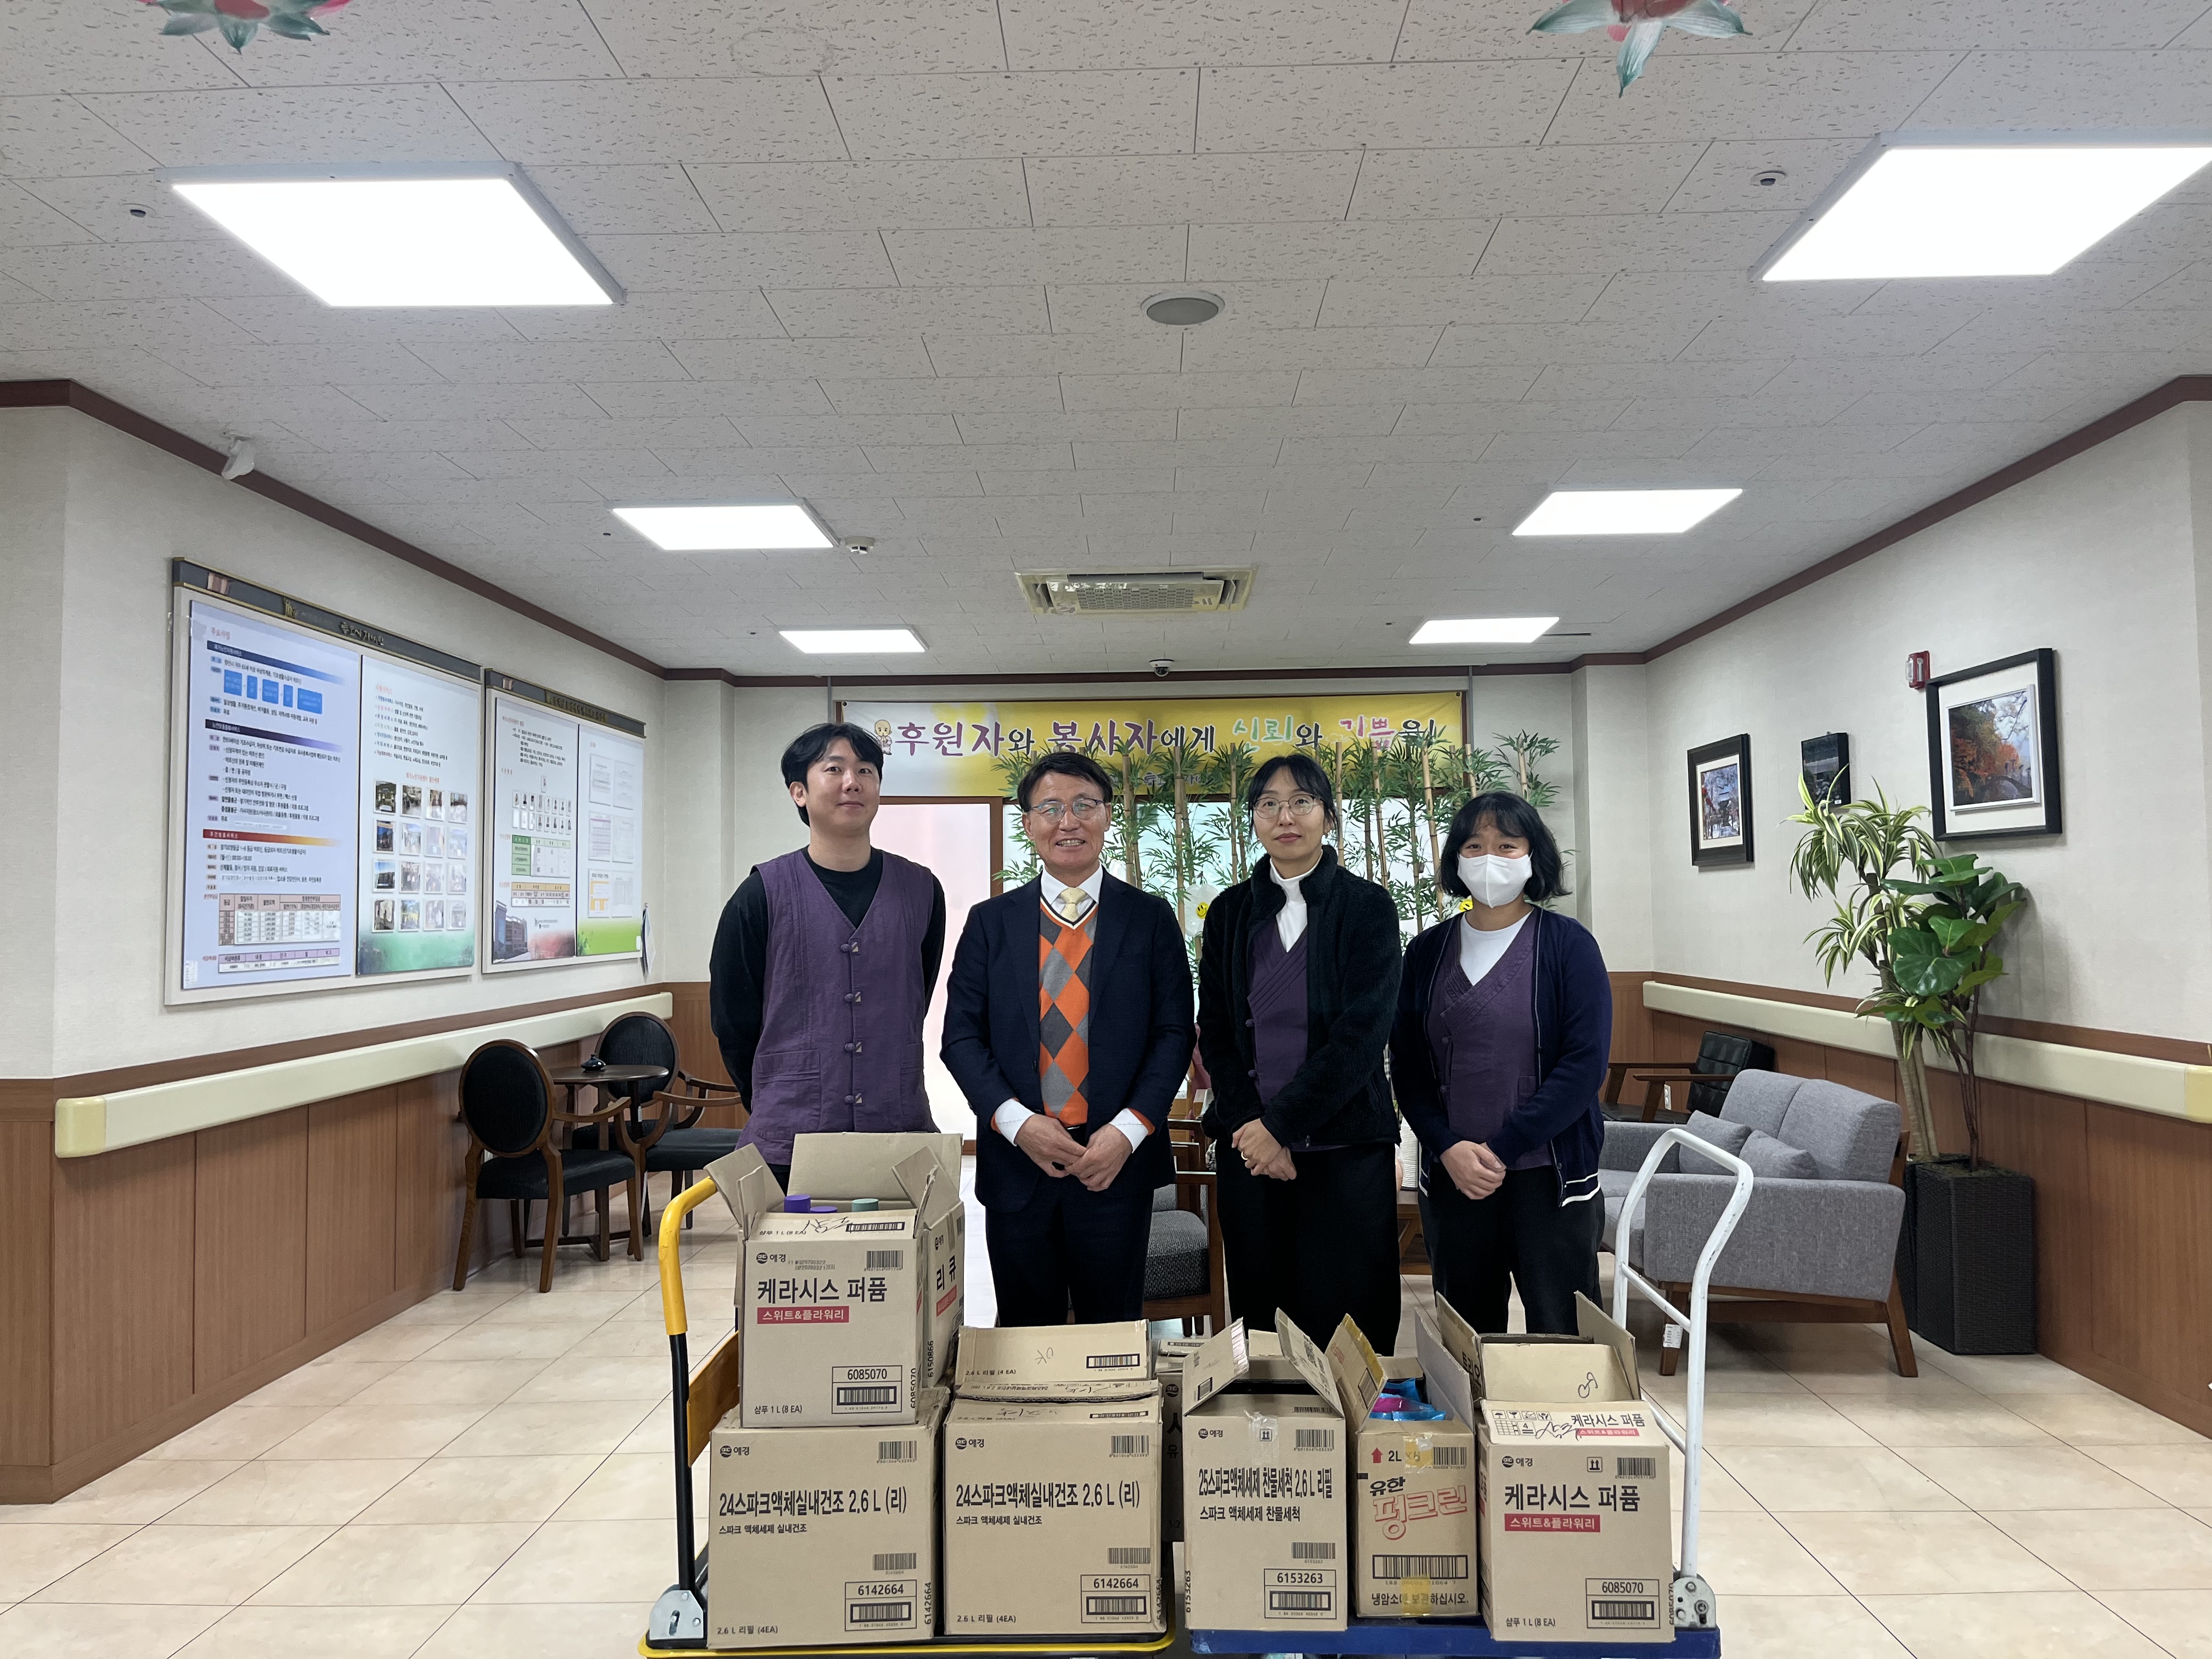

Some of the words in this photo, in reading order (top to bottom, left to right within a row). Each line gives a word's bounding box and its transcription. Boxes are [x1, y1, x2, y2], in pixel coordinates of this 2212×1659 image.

[894, 720, 1036, 757] 후원자와
[1047, 719, 1216, 757] 봉사자에게
[1233, 715, 1323, 752] 신뢰와
[769, 1254, 787, 1262] 애경
[757, 1277, 839, 1304] 케라시스
[847, 1277, 888, 1302] 퍼퓸
[762, 1309, 844, 1321] 스위트&플라워리
[848, 1368, 887, 1380] 6085070
[754, 1406, 769, 1414] 샴푸
[782, 1405, 789, 1414] (8
[790, 1404, 803, 1414] EA)
[1571, 1414, 1620, 1427] 케라시스
[1620, 1413, 1646, 1427] 퍼퓸
[968, 1438, 985, 1448] 애경
[733, 1446, 750, 1456] 애경
[1388, 1450, 1402, 1462] 2L
[1515, 1458, 1533, 1467] 애경
[1199, 1466, 1260, 1499] 25스파크액체세제
[1262, 1466, 1293, 1499] 찬물세척
[1295, 1468, 1309, 1497] 2.6
[1310, 1470, 1315, 1497] L
[1317, 1468, 1333, 1499] 리필
[1369, 1476, 1406, 1496] 유한
[956, 1482, 1079, 1509] 24스파크액체실내건조
[1082, 1483, 1102, 1507] 2.6
[1107, 1483, 1115, 1505] L
[1119, 1480, 1140, 1509] (리)
[1504, 1483, 1590, 1512] 케라시스
[1598, 1484, 1640, 1512] 퍼퓸
[719, 1489, 844, 1517] 24스파크액체실내건조
[849, 1489, 868, 1514] 2.6
[873, 1489, 881, 1511] L
[885, 1486, 907, 1514] (리)
[1199, 1506, 1226, 1520] 스파크
[1228, 1506, 1263, 1522] 액체세제
[1266, 1506, 1301, 1522] 찬물세척
[1373, 1485, 1468, 1541] 펑크린
[956, 1516, 978, 1525] 스파크
[981, 1515, 1011, 1525] 액체세제
[1013, 1515, 1042, 1525] 실내건조
[1509, 1517, 1595, 1530] 스위트&플라워리
[719, 1524, 741, 1534] 스파크
[744, 1523, 775, 1534] 액체세제
[777, 1523, 807, 1533] 실내건조
[1093, 1578, 1139, 1589] 6142664
[1277, 1572, 1323, 1583] 6153263
[858, 1583, 904, 1595] 6142664
[1601, 1581, 1644, 1594] 6085070
[924, 1582, 932, 1625] 6142664
[1372, 1592, 1408, 1606] 냉암소에
[1412, 1592, 1469, 1605] 보관하십시오.
[957, 1615, 968, 1623] 2.6
[978, 1613, 993, 1623] 리필
[996, 1613, 1016, 1623] (4EA)
[1505, 1617, 1520, 1627] 샴푸
[1522, 1617, 1526, 1627] 1
[1528, 1617, 1533, 1627] L
[1534, 1616, 1542, 1627] (8
[1543, 1616, 1556, 1627] EA)
[738, 1626, 754, 1634] 리필
[758, 1626, 778, 1634] (4EA)
